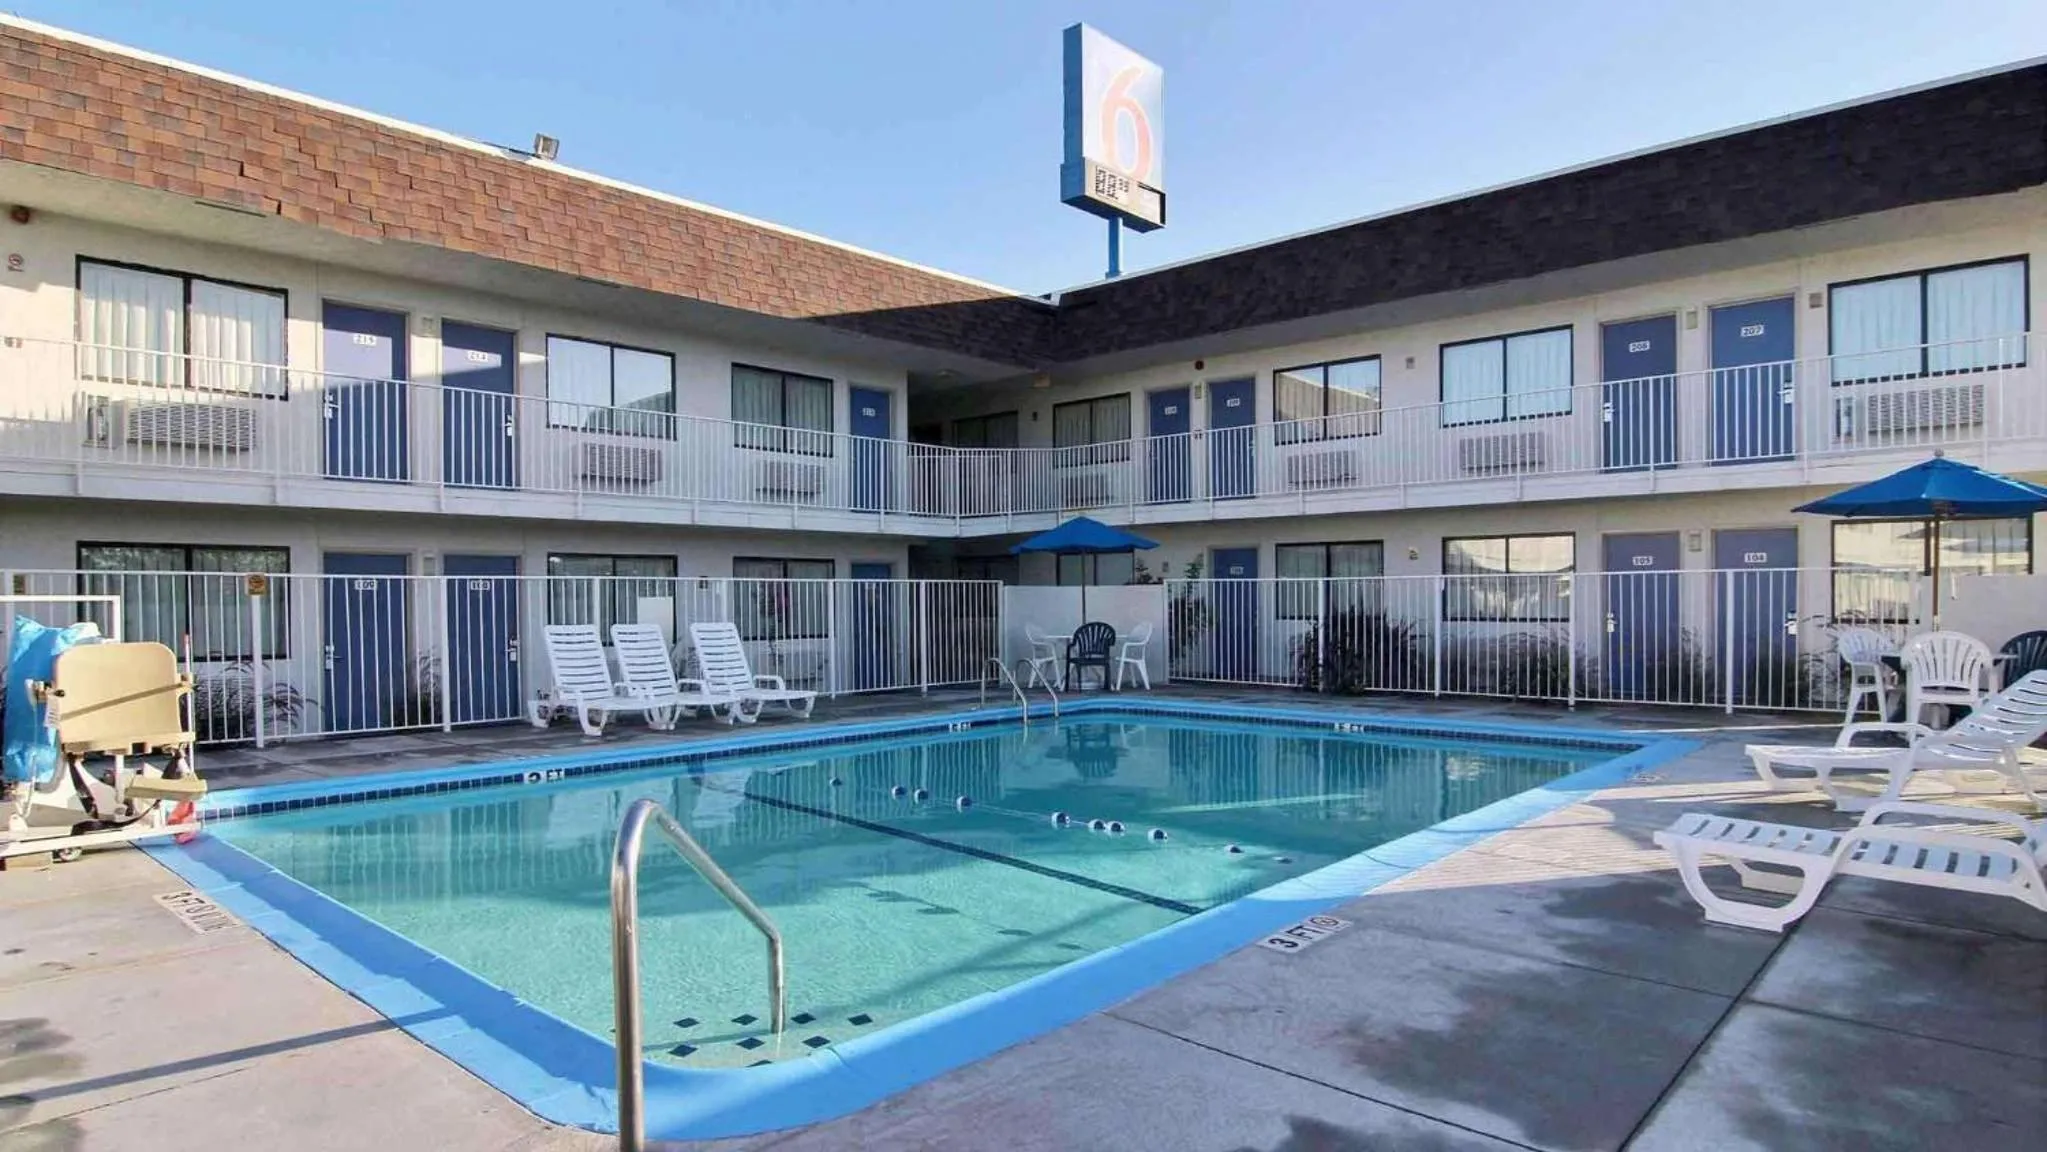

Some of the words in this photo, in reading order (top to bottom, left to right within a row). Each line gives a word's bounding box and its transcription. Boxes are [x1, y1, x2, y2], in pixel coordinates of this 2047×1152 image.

[1102, 65, 1153, 180] 6
[1268, 938, 1298, 948] 3
[1286, 925, 1324, 940] FT
